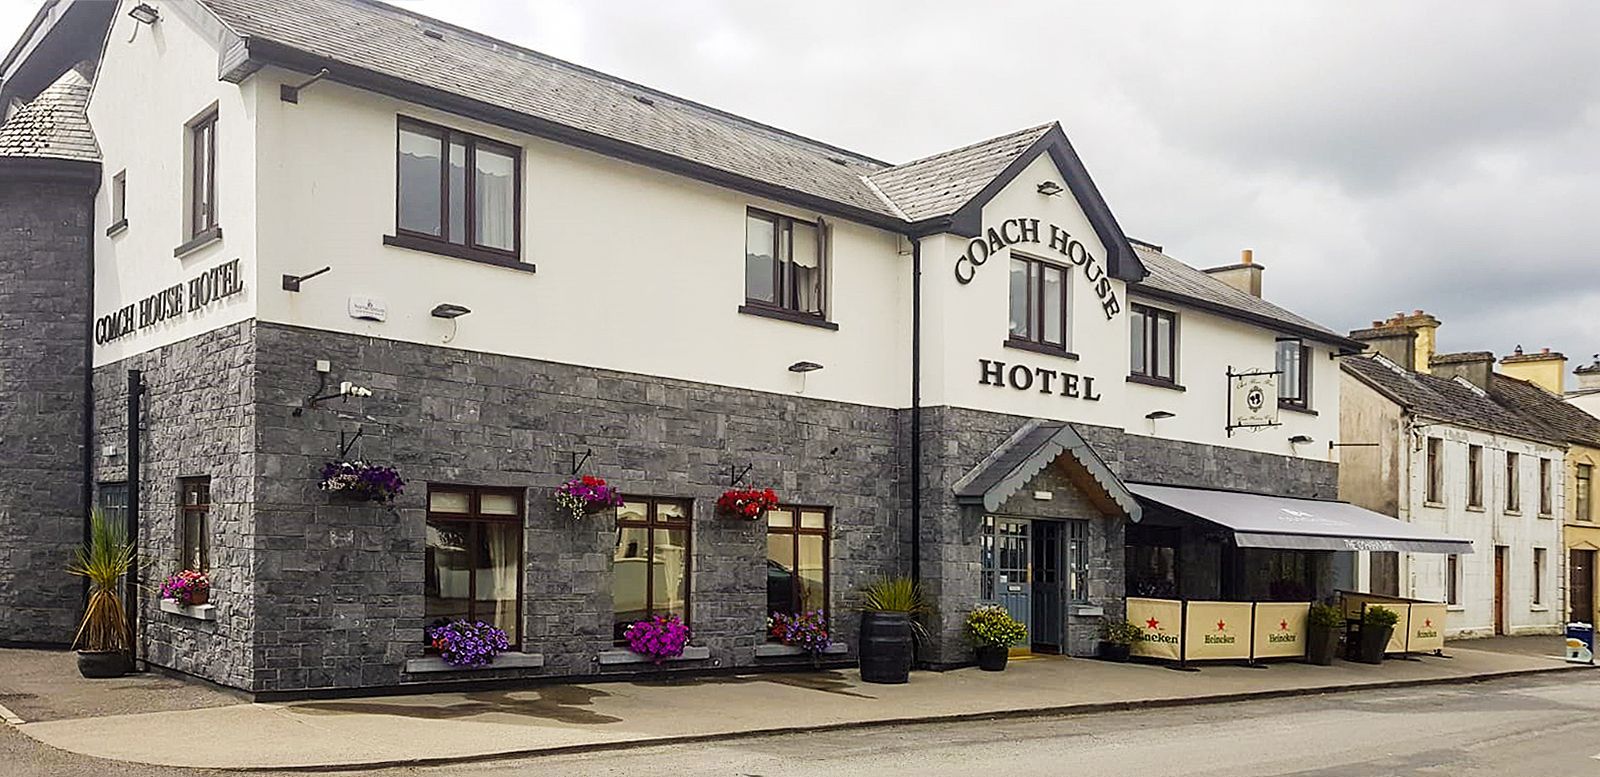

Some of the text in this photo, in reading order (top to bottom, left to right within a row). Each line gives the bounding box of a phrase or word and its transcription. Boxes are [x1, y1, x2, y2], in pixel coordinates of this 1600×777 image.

[95, 258, 244, 345] COACH HOUSE HOTEL
[955, 218, 1121, 321] COACH HOUSE
[978, 358, 1101, 402] HOTEL
